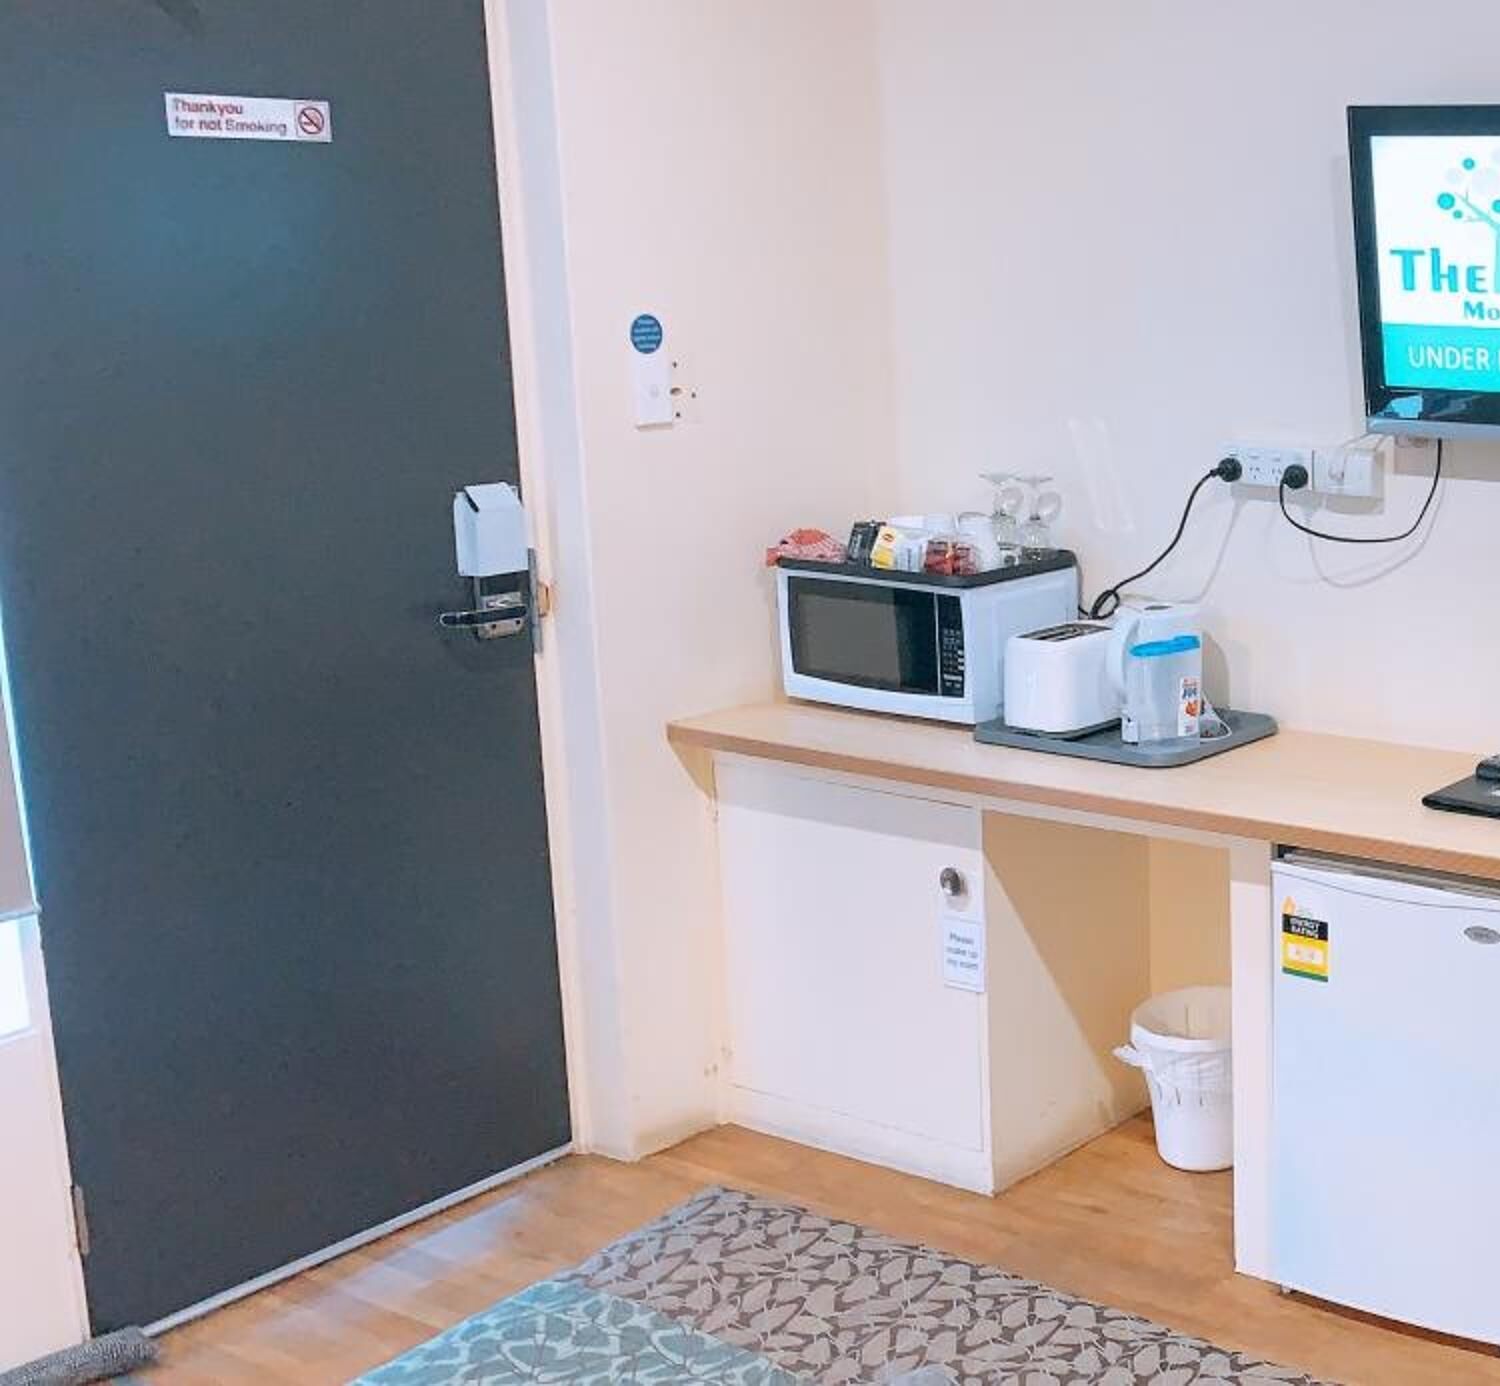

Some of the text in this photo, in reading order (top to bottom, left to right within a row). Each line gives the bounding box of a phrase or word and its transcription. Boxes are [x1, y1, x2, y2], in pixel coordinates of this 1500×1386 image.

[173, 98, 243, 115] Thankyou
[175, 116, 287, 136] for not Smoking
[1407, 345, 1490, 371] UNDER
